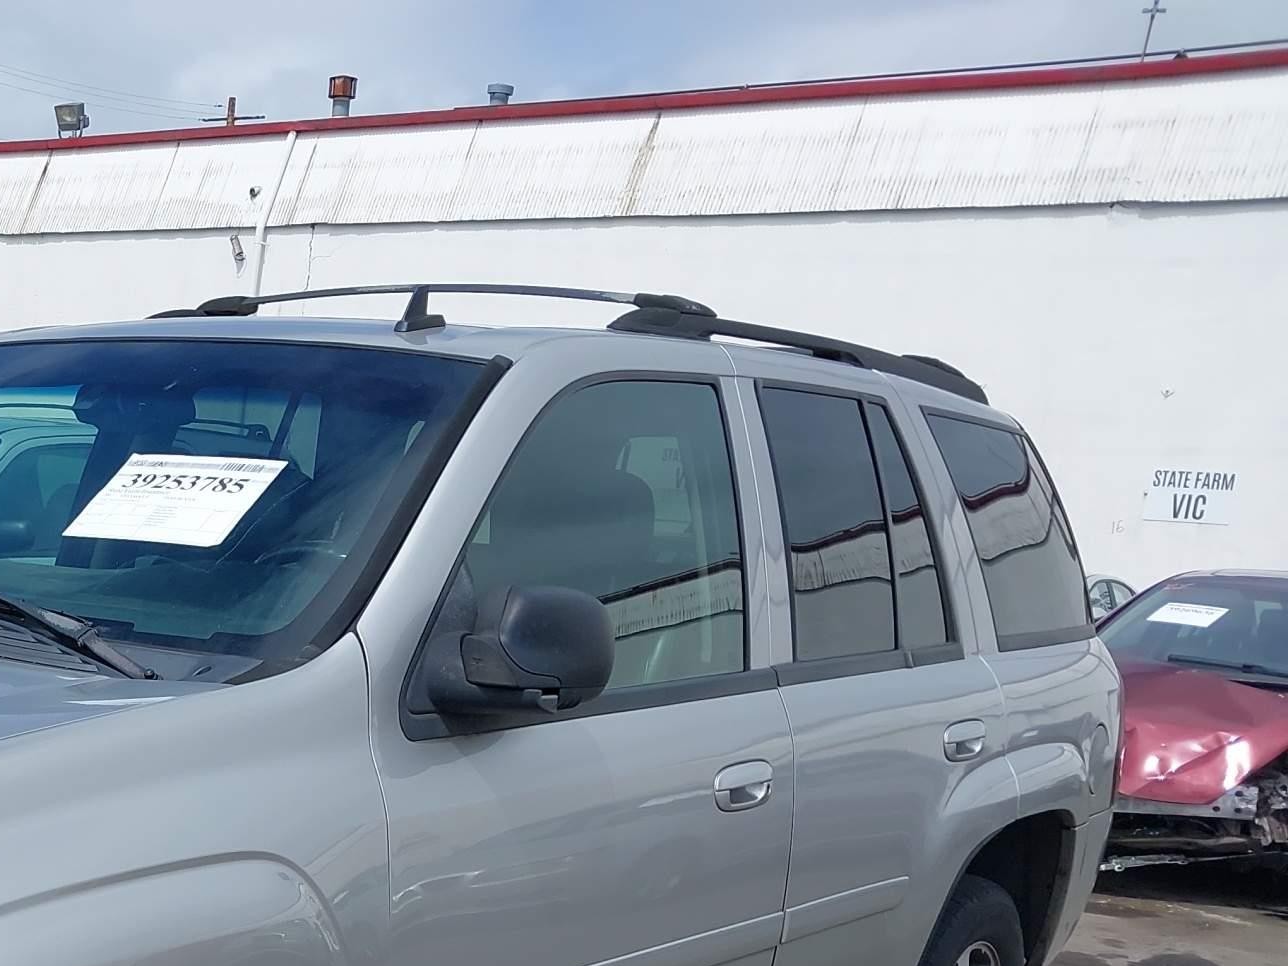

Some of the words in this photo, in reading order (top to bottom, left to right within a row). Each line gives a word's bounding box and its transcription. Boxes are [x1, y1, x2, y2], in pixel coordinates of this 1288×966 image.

[121, 473, 252, 494] 39253785
[1152, 469, 1192, 489] STATE
[1193, 471, 1236, 491] FARM
[1171, 493, 1207, 520] VIC
[1111, 519, 1126, 534] 16
